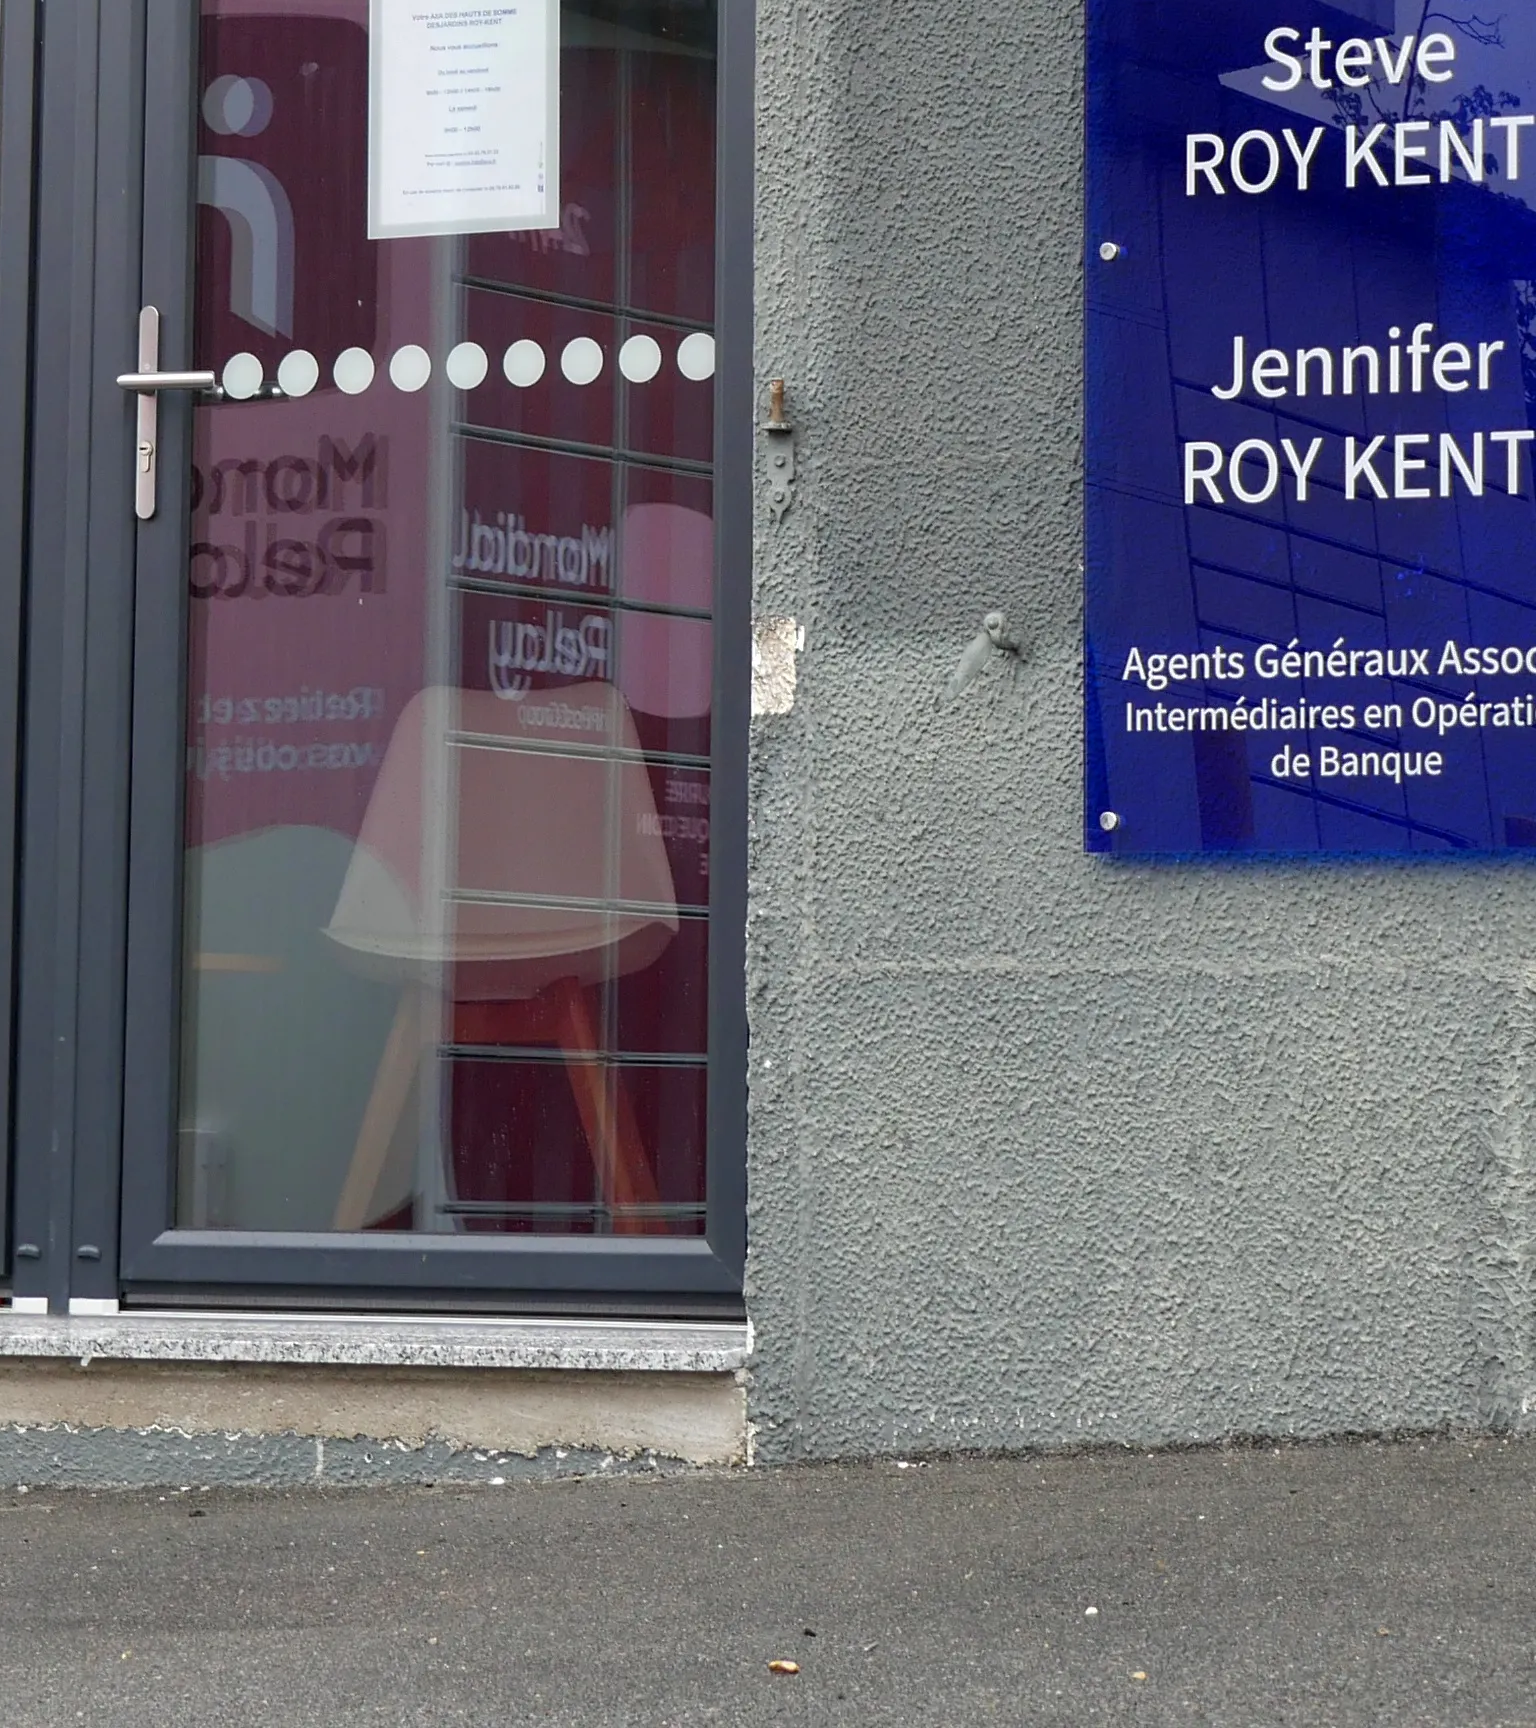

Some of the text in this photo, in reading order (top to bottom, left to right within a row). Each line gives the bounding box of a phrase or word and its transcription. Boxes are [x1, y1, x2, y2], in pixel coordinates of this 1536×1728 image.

[1261, 26, 1455, 92] Steve
[1185, 115, 1535, 196] ROY KENT
[1212, 323, 1504, 400] Jennifer
[1183, 429, 1535, 505] ROY KENT
[1122, 646, 1245, 690] Agents
[1254, 639, 1429, 678] Généraux
[1125, 696, 1355, 732] Intermédiaires
[1364, 705, 1402, 729] en
[1271, 746, 1442, 783] de Banque
